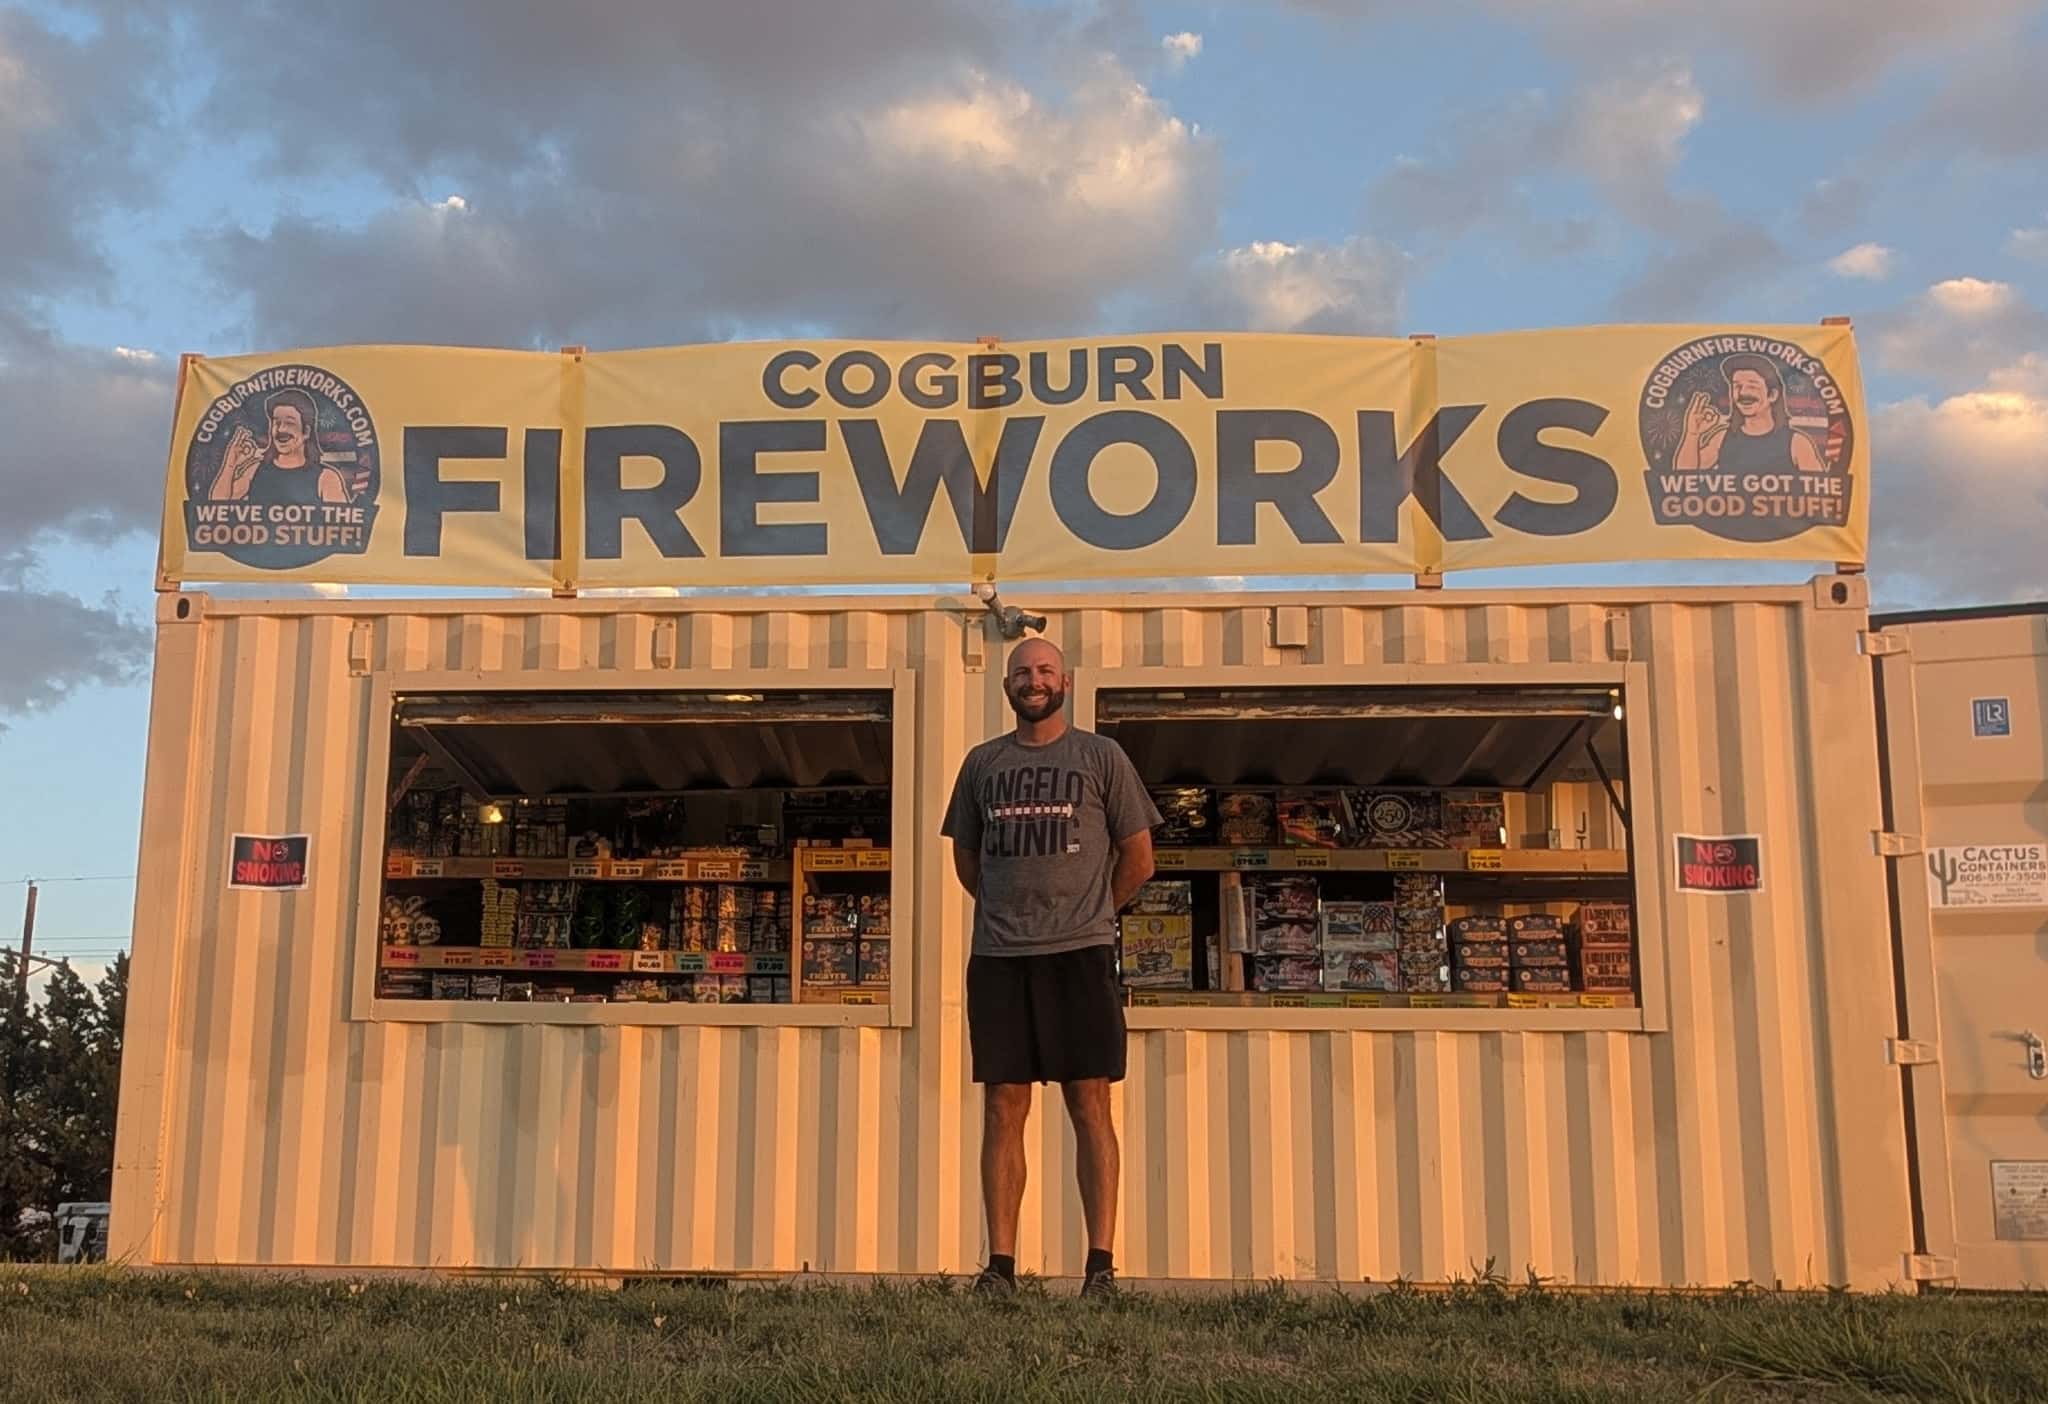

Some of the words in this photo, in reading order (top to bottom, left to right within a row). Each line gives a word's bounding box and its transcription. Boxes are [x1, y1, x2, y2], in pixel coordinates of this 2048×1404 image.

[762, 343, 1223, 410] COGBURN
[1646, 337, 1844, 415] COGBURNFIREWORKS.COM
[197, 369, 374, 447] COGBURNFIREWORKS.COM
[402, 398, 1619, 562] FIREWORKS
[1660, 475, 1737, 493] WE'VE
[1743, 475, 1793, 492] GOT
[1799, 476, 1842, 496] THE
[196, 505, 263, 522] WE'VE
[268, 505, 316, 523] GOT
[321, 506, 364, 524] THE
[1662, 496, 1745, 517] GOOD
[1753, 496, 1842, 519] STUFF!
[194, 525, 269, 545] GOOD
[274, 525, 362, 546] STUFF!
[982, 767, 1084, 807] ANGELO
[984, 816, 1081, 857] CLINIC
[1963, 847, 2040, 861] CACTUS
[237, 861, 301, 883] SMOKING
[1684, 863, 1756, 887] SMOKING
[1958, 860, 2047, 873] CONTAINERS
